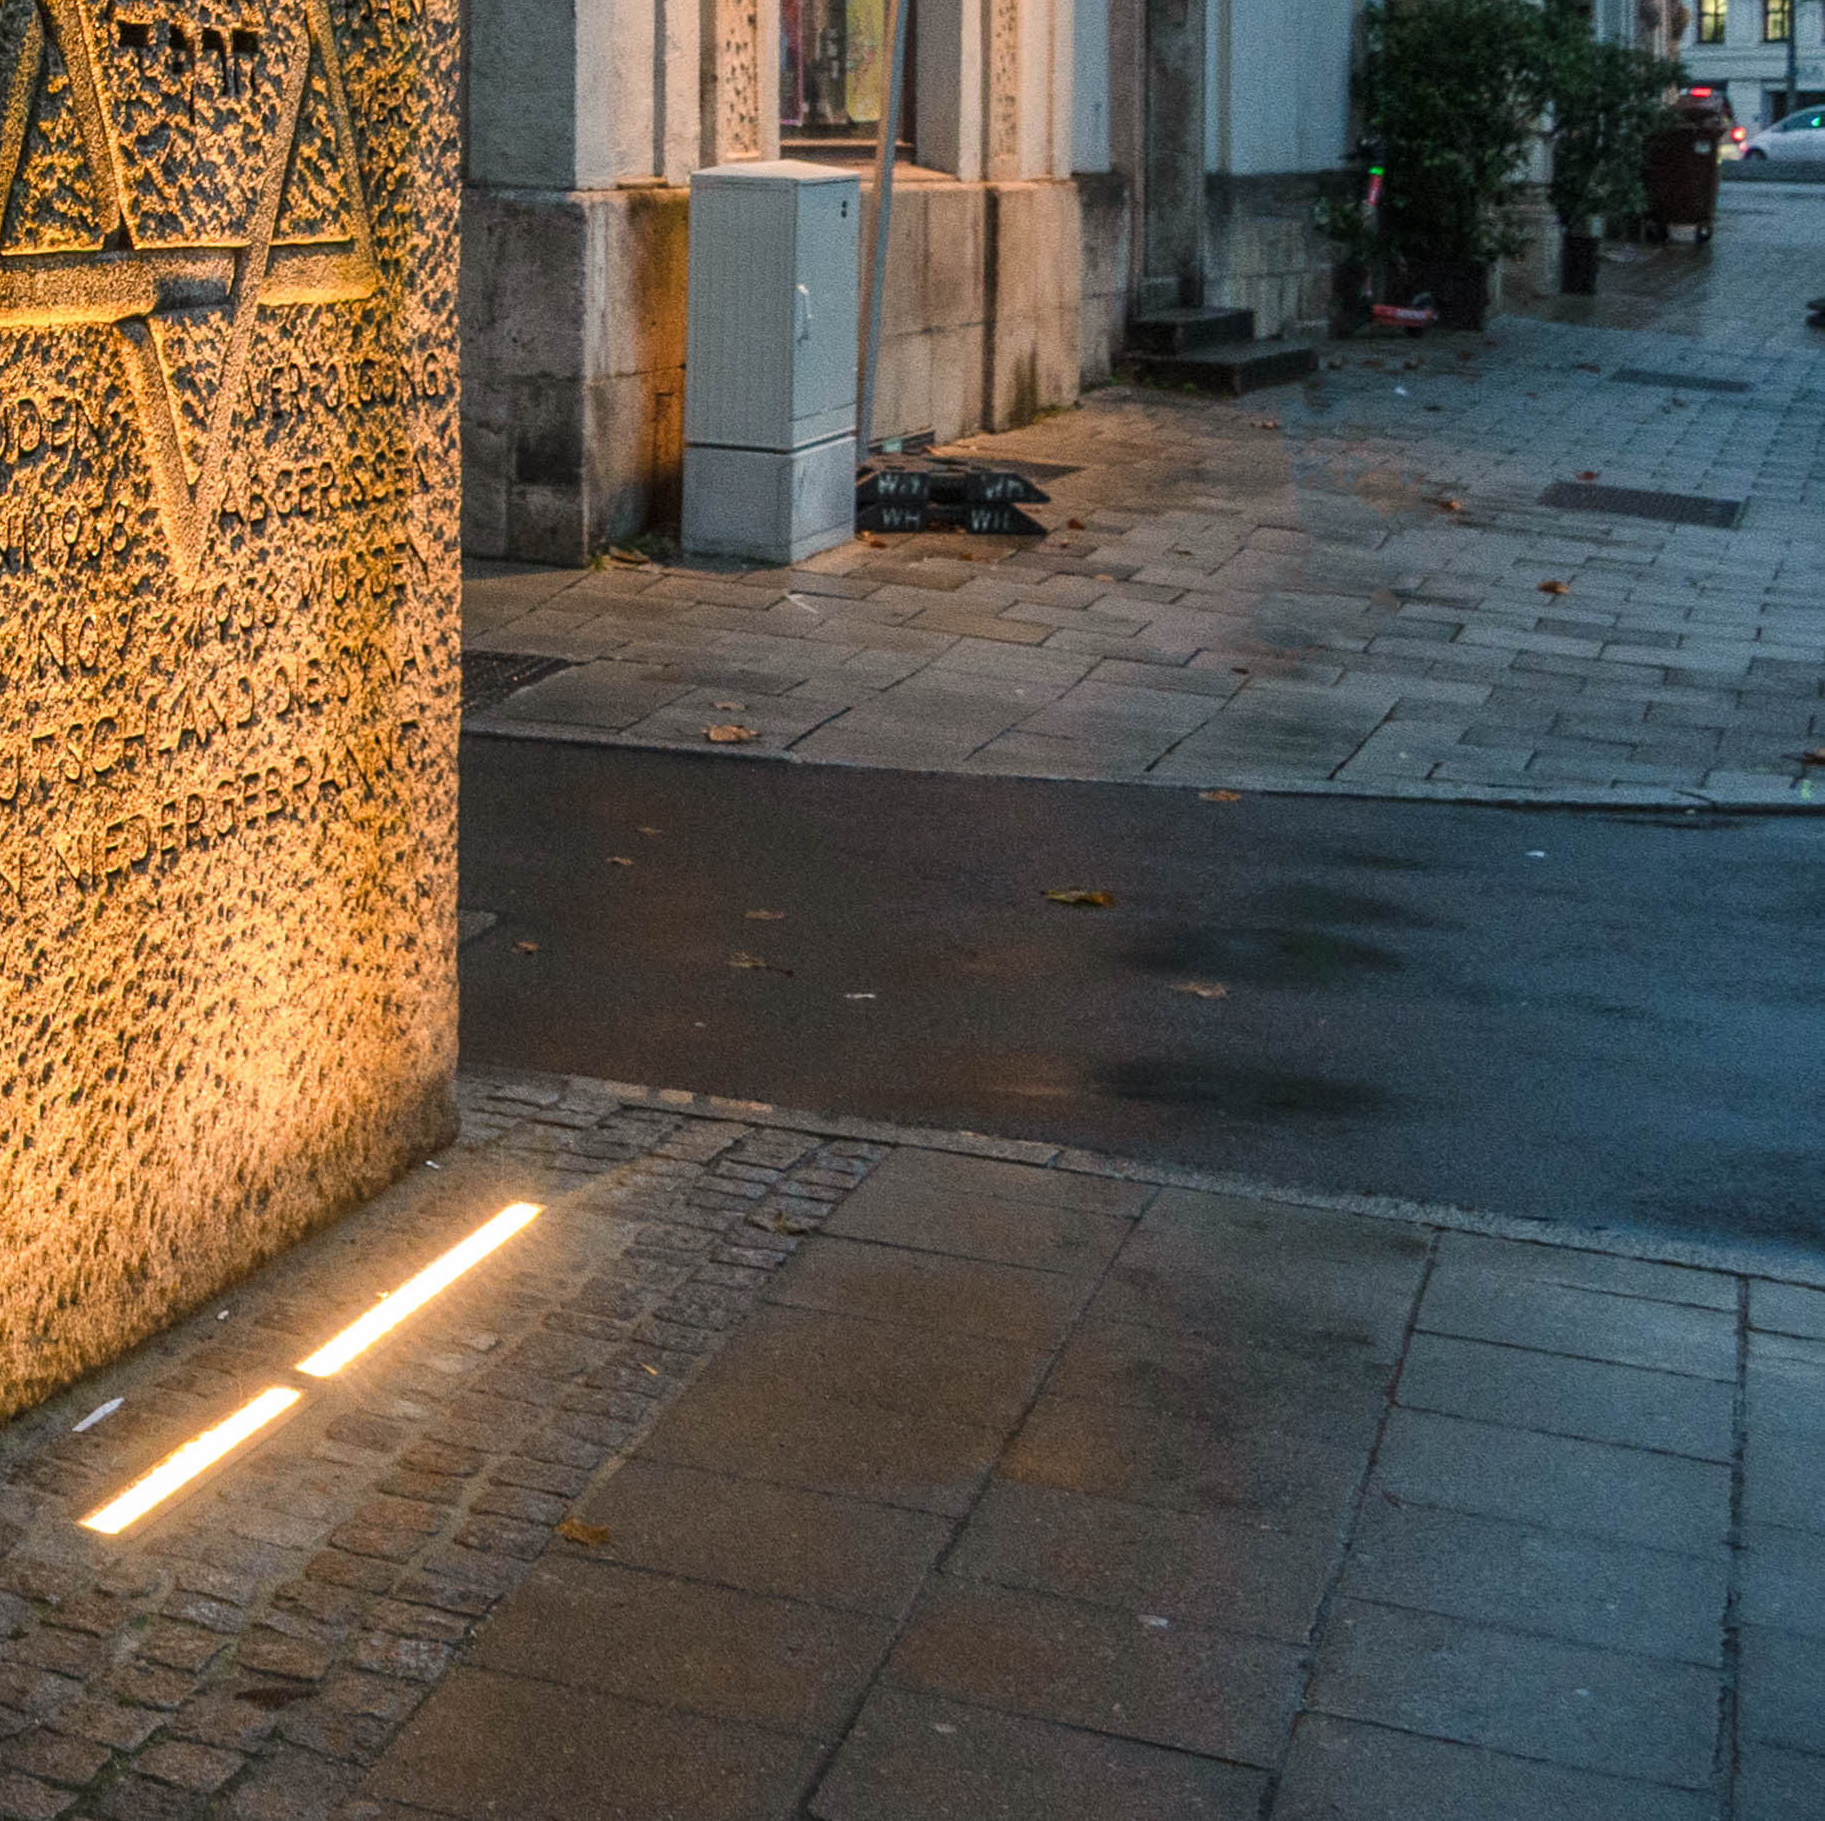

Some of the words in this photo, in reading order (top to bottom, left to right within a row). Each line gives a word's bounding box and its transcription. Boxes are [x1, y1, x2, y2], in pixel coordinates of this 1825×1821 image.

[243, 351, 440, 416] VERFOLGUNG
[219, 445, 430, 528] ABGERISSEN
[299, 535, 431, 606] WURDEN
[275, 656, 321, 716] DIE
